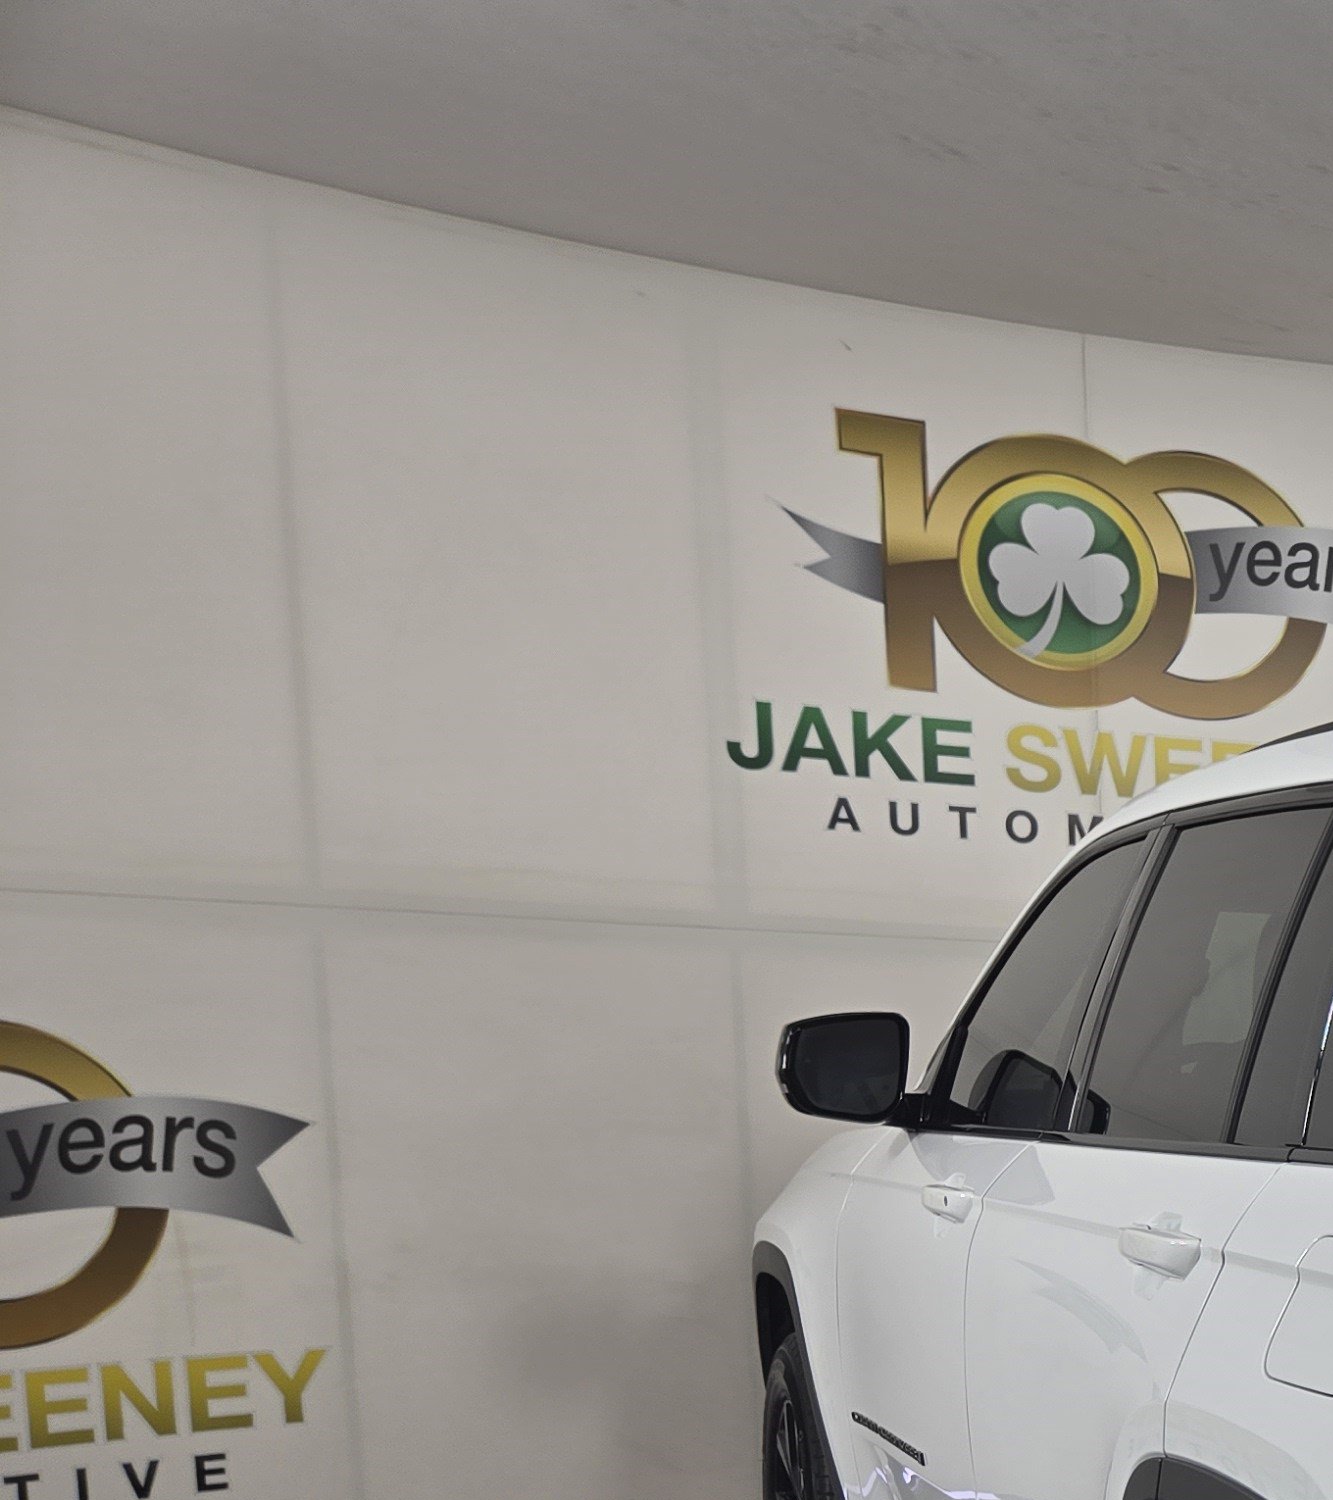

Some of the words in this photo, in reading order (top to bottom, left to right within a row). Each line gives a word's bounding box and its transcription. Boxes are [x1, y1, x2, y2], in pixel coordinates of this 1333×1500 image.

[834, 406, 1328, 721] 100
[726, 700, 977, 787] JAKE
[6, 1113, 237, 1200] years
[0, 1347, 327, 1453] ENEY
